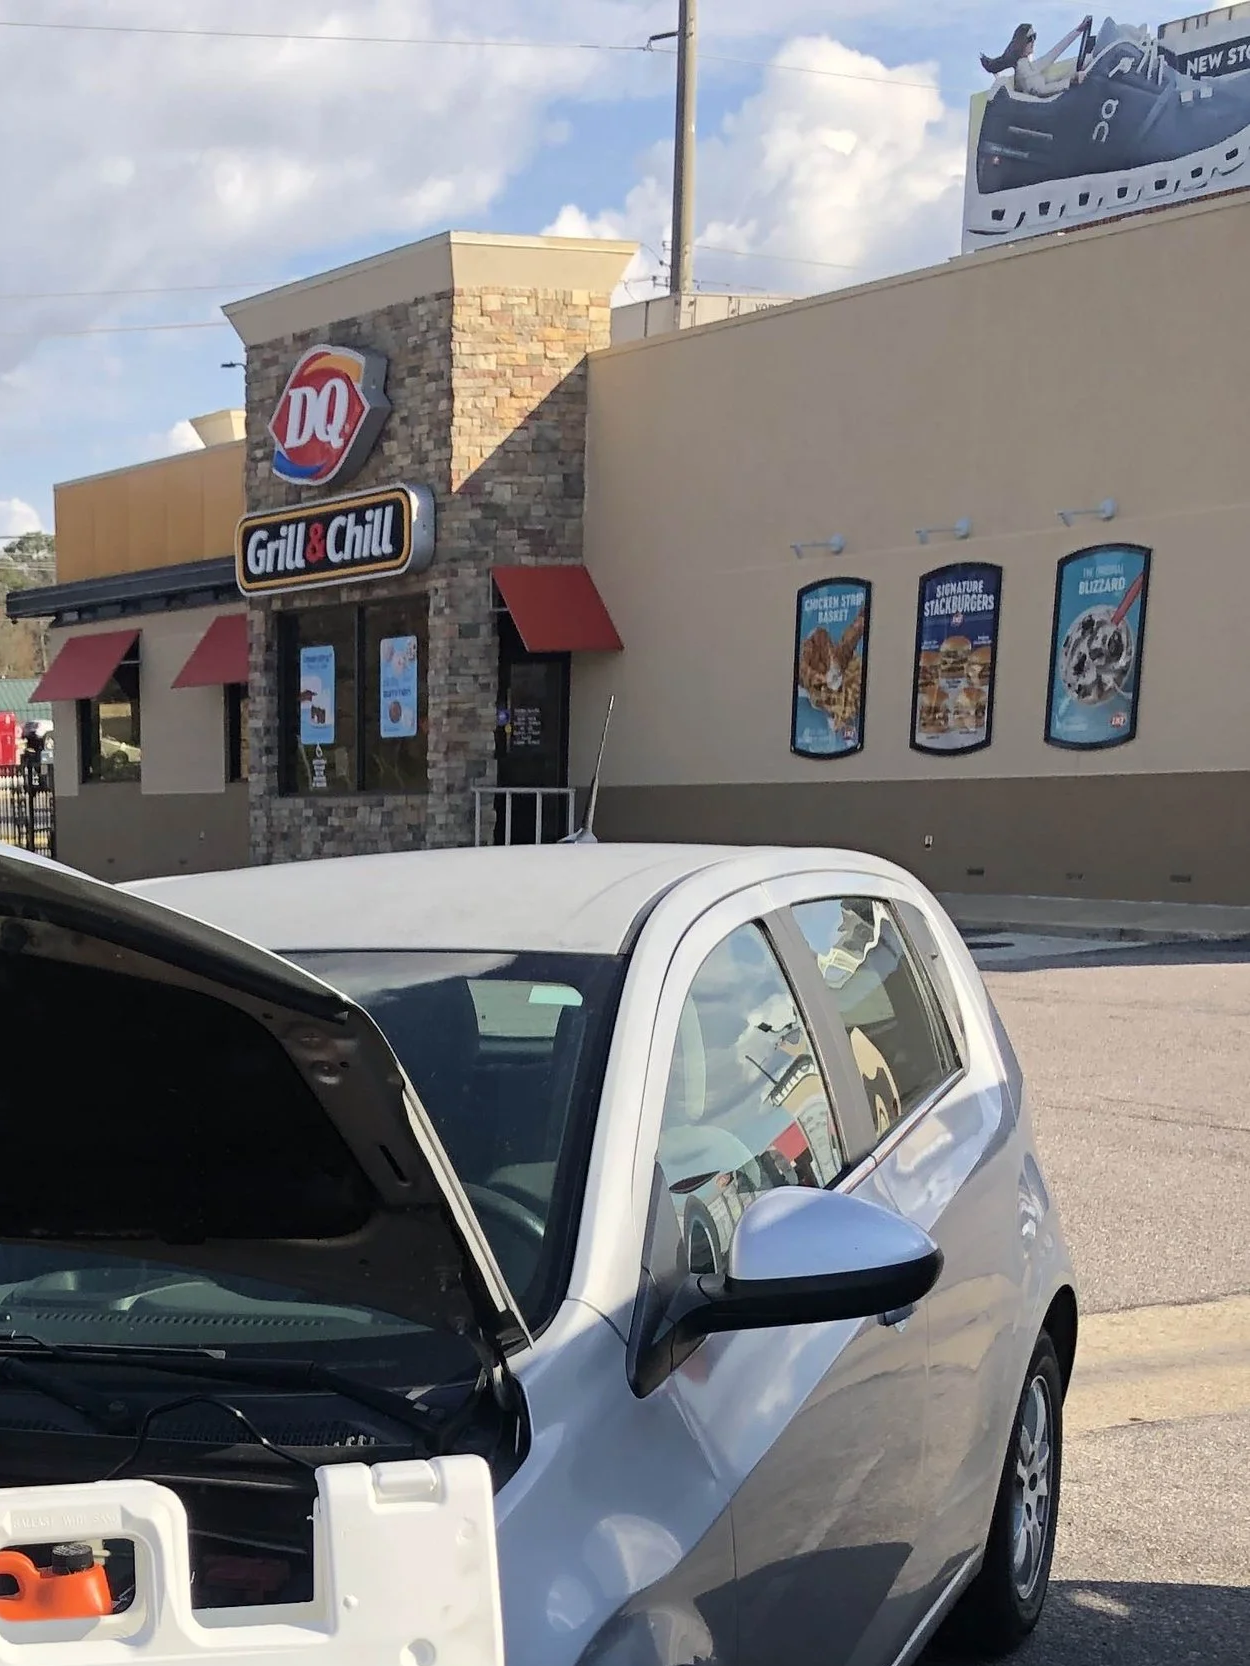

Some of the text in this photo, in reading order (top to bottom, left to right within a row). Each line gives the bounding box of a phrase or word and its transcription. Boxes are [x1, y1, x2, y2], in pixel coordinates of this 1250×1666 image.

[1186, 50, 1224, 76] NEW
[284, 378, 349, 450] DQ
[936, 580, 984, 598] SIGNATURE
[1078, 576, 1126, 595] BLIZZARD
[923, 593, 995, 617] STACKBURGERS
[818, 609, 849, 625] BASKET
